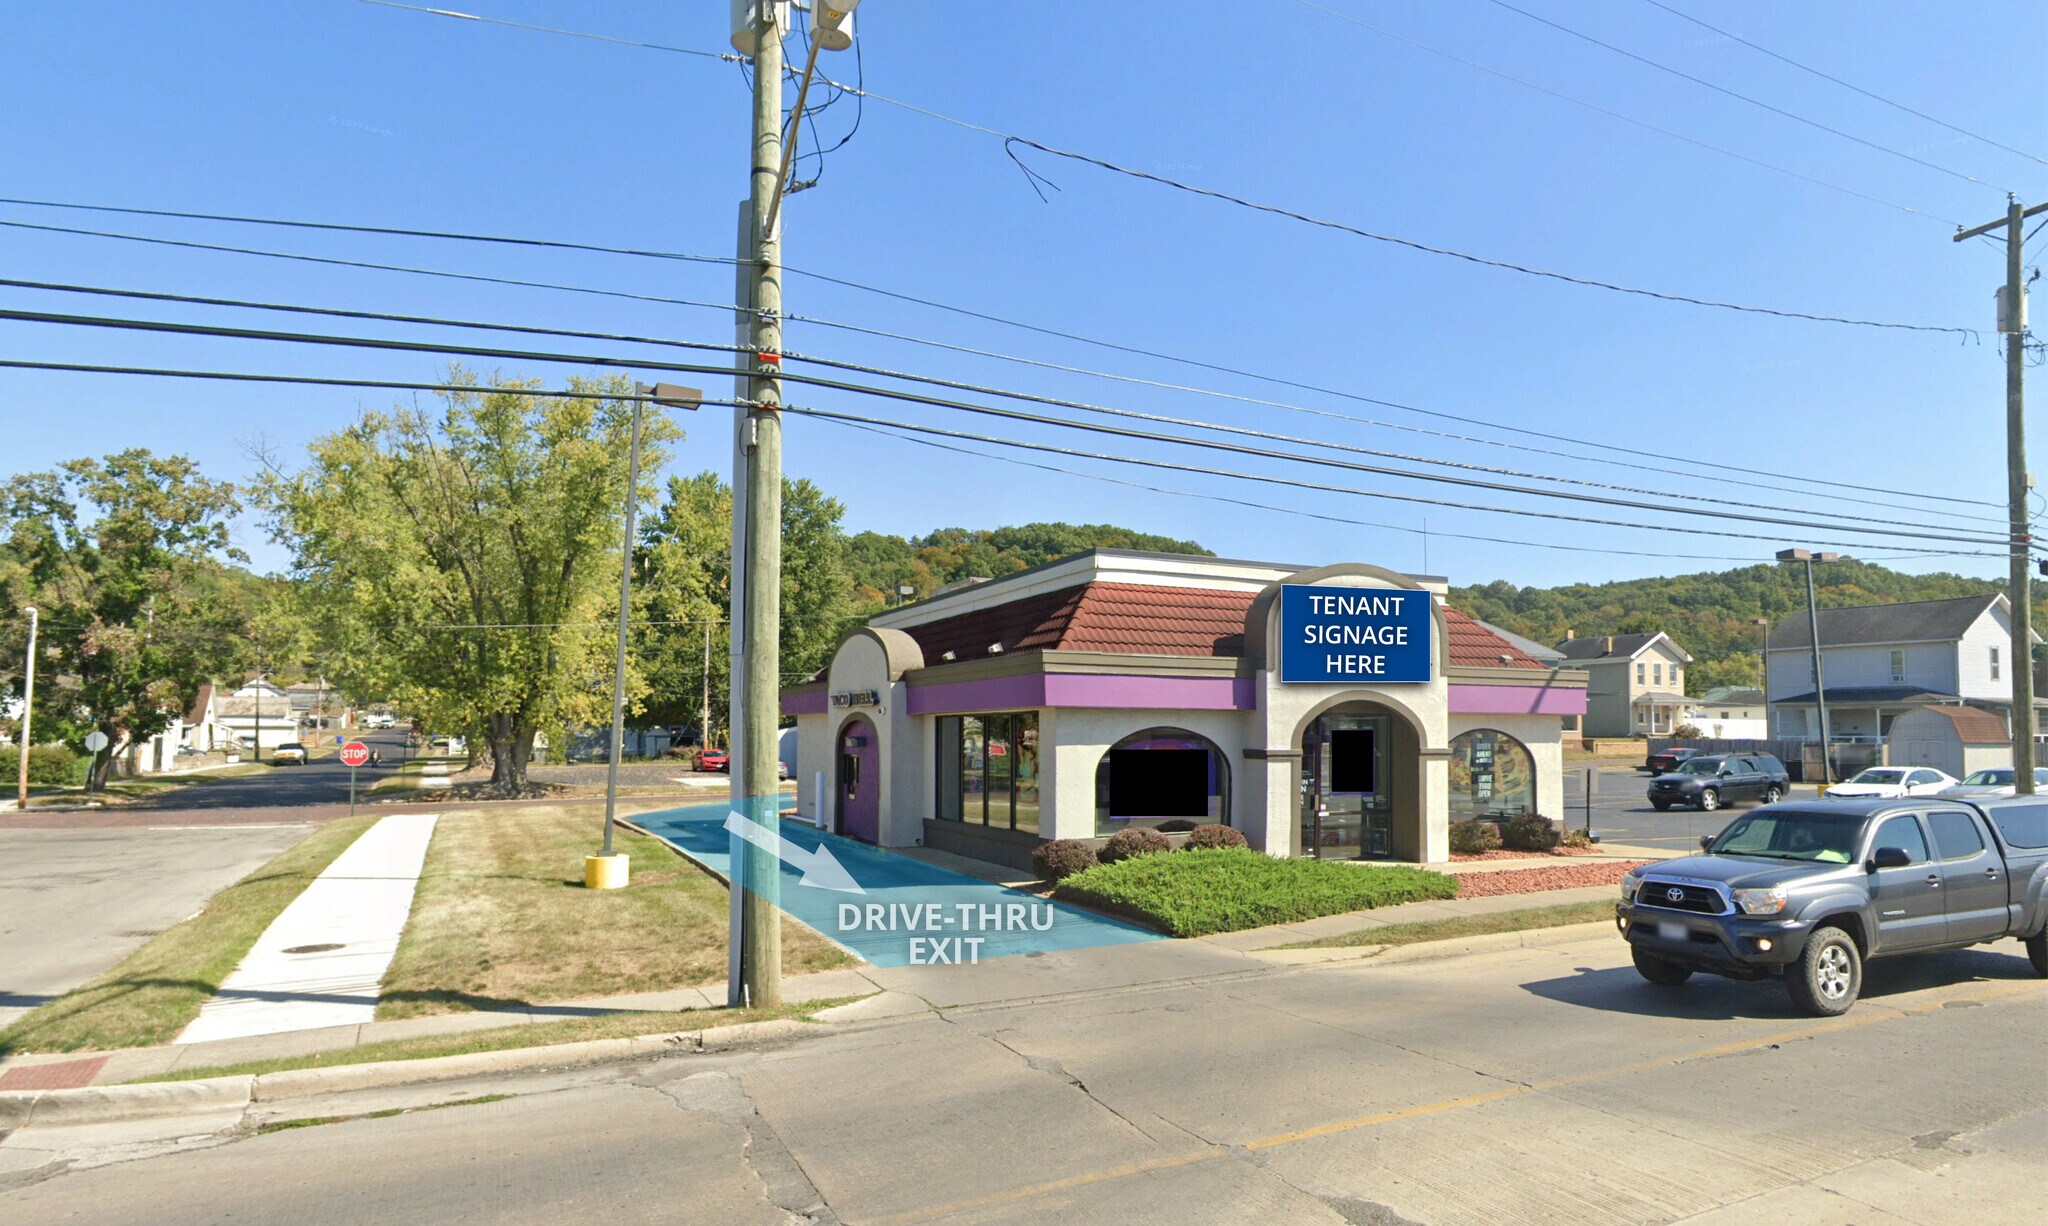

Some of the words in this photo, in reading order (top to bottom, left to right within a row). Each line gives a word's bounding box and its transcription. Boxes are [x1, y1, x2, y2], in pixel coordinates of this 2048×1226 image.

[1309, 595, 1405, 616] TENANT
[1304, 625, 1408, 645] SIGNAGE
[1326, 654, 1386, 674] HERE
[830, 694, 850, 707] TACO
[851, 690, 874, 706] BELL
[342, 749, 367, 759] STOP
